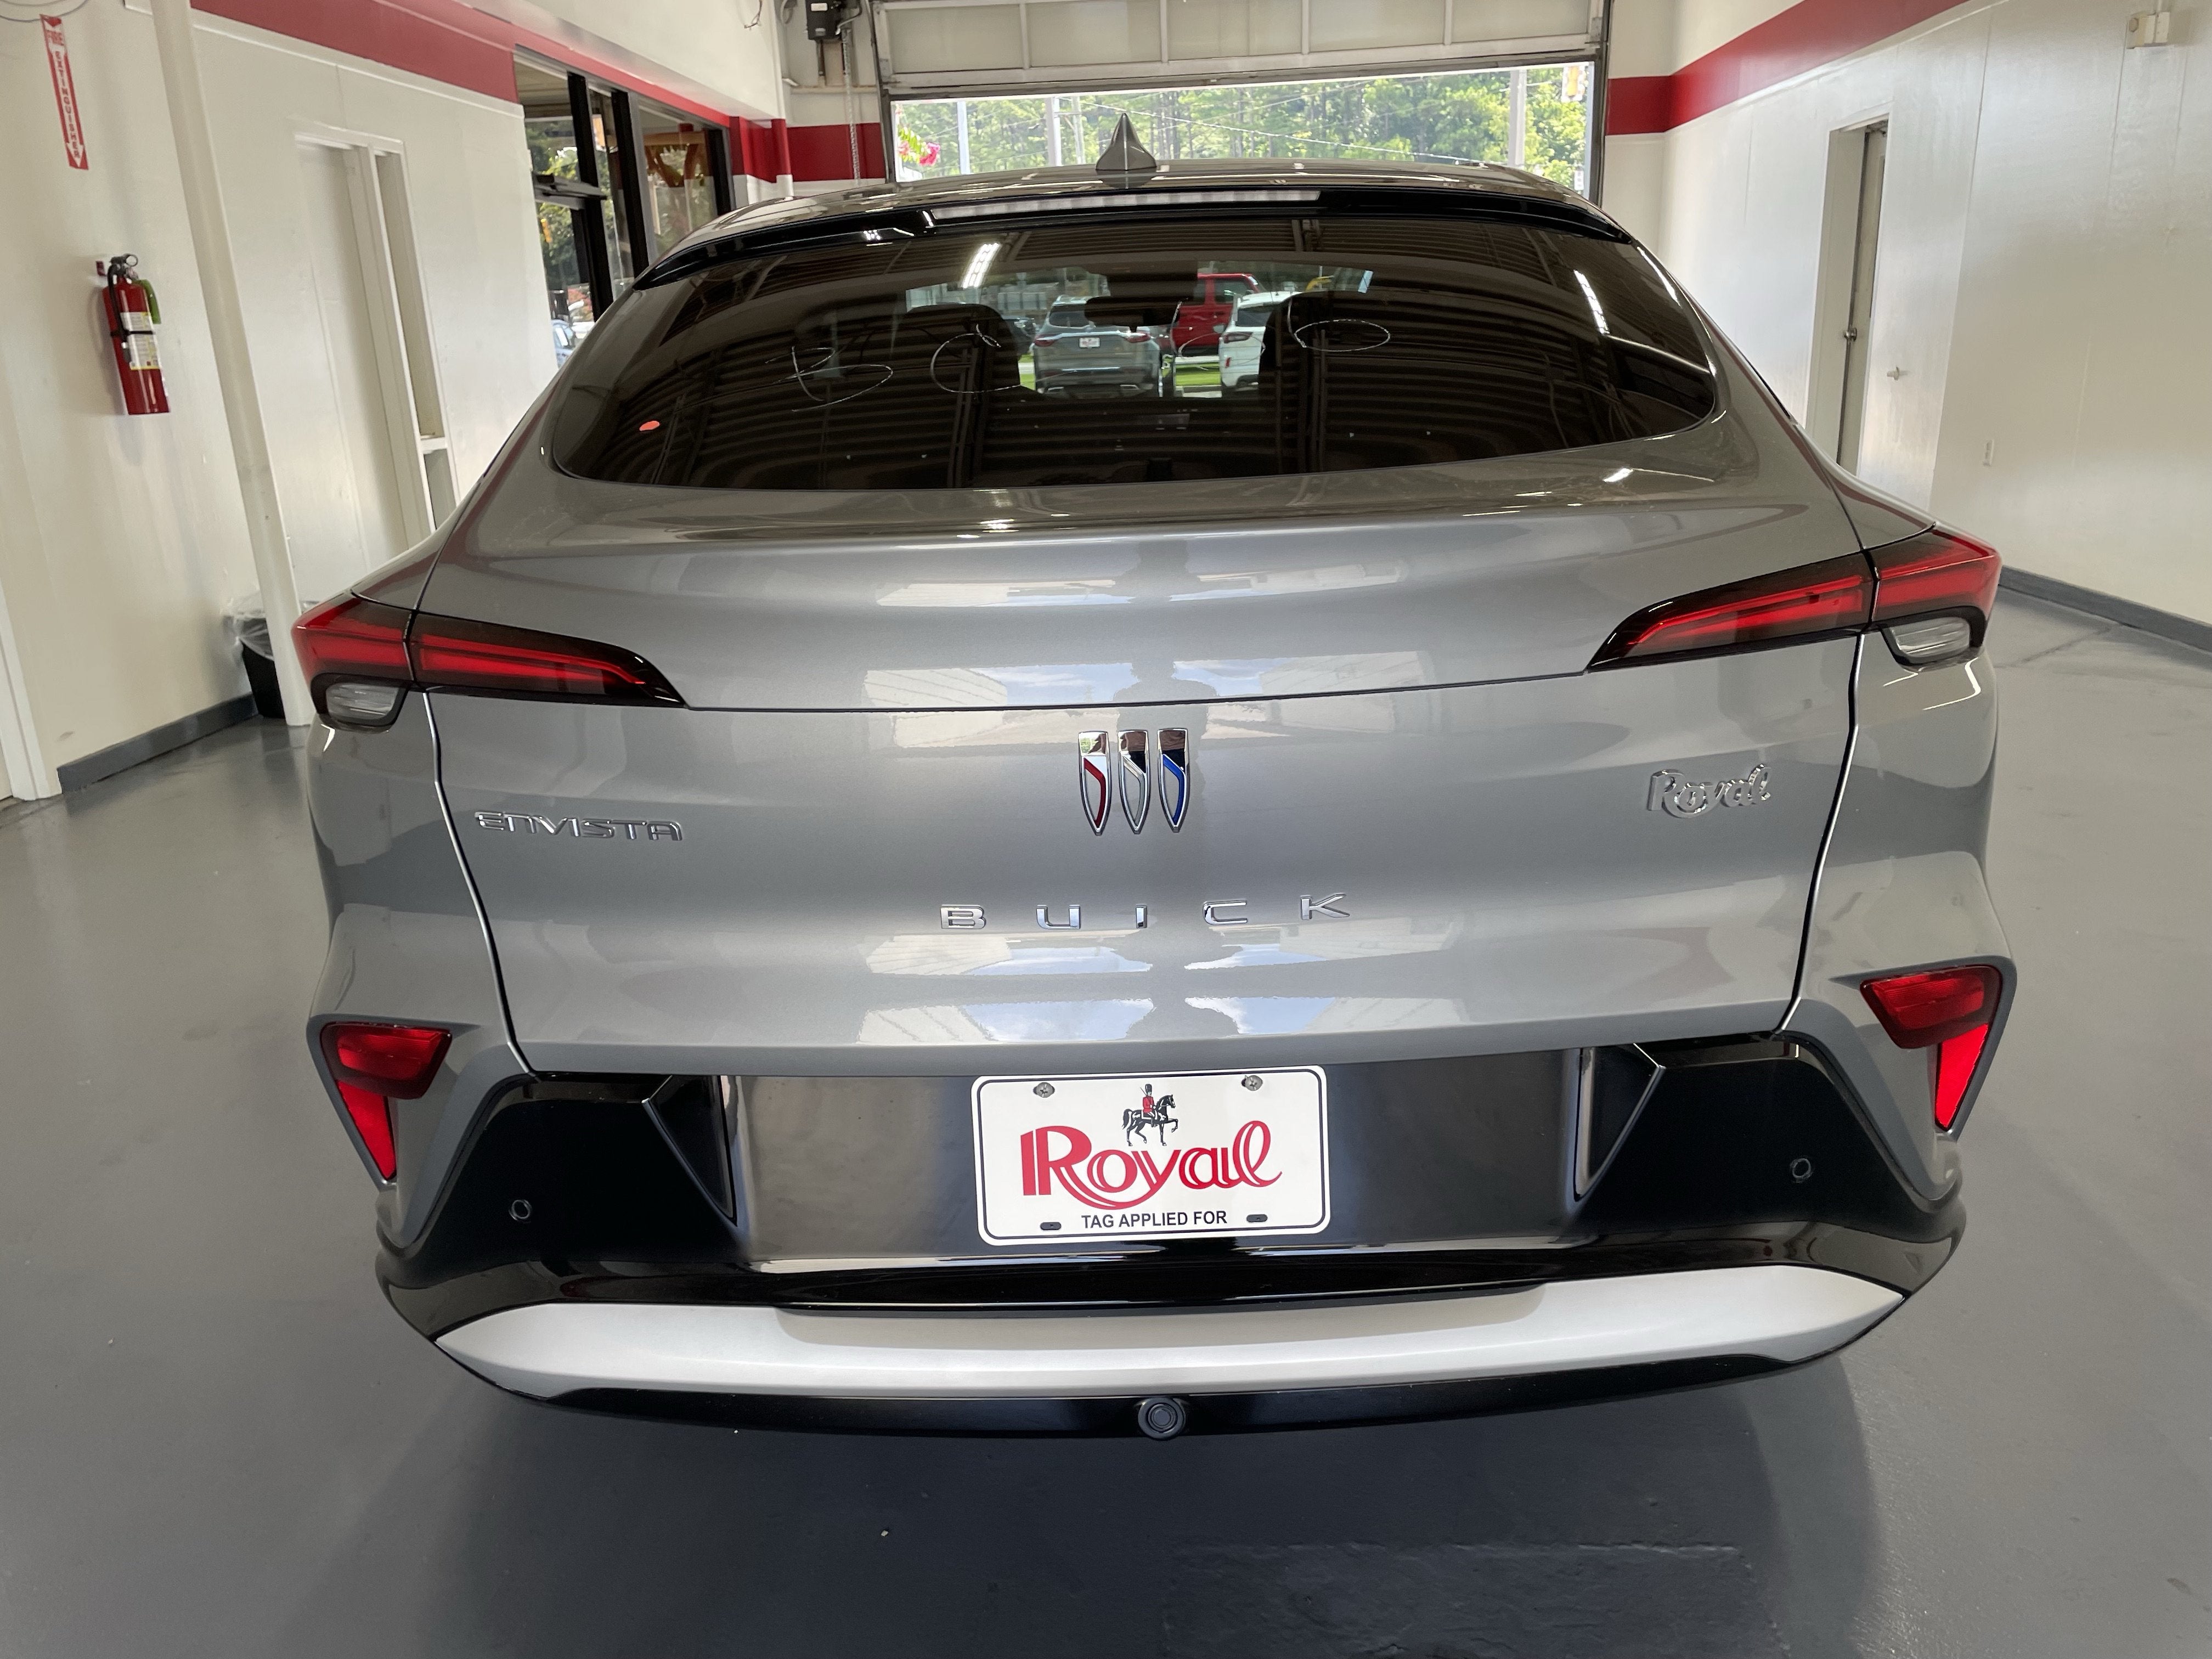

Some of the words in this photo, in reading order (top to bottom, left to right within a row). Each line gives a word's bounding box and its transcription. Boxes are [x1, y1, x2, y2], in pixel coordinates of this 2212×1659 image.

[1647, 763, 1771, 819] Royal
[475, 810, 682, 841] ENVISTA
[940, 892, 1351, 930] BUICK
[1020, 1120, 1283, 1210] Royal
[1081, 1214, 1114, 1228] TAG
[1118, 1211, 1188, 1228] APPLIED
[1193, 1210, 1228, 1225] FOR
